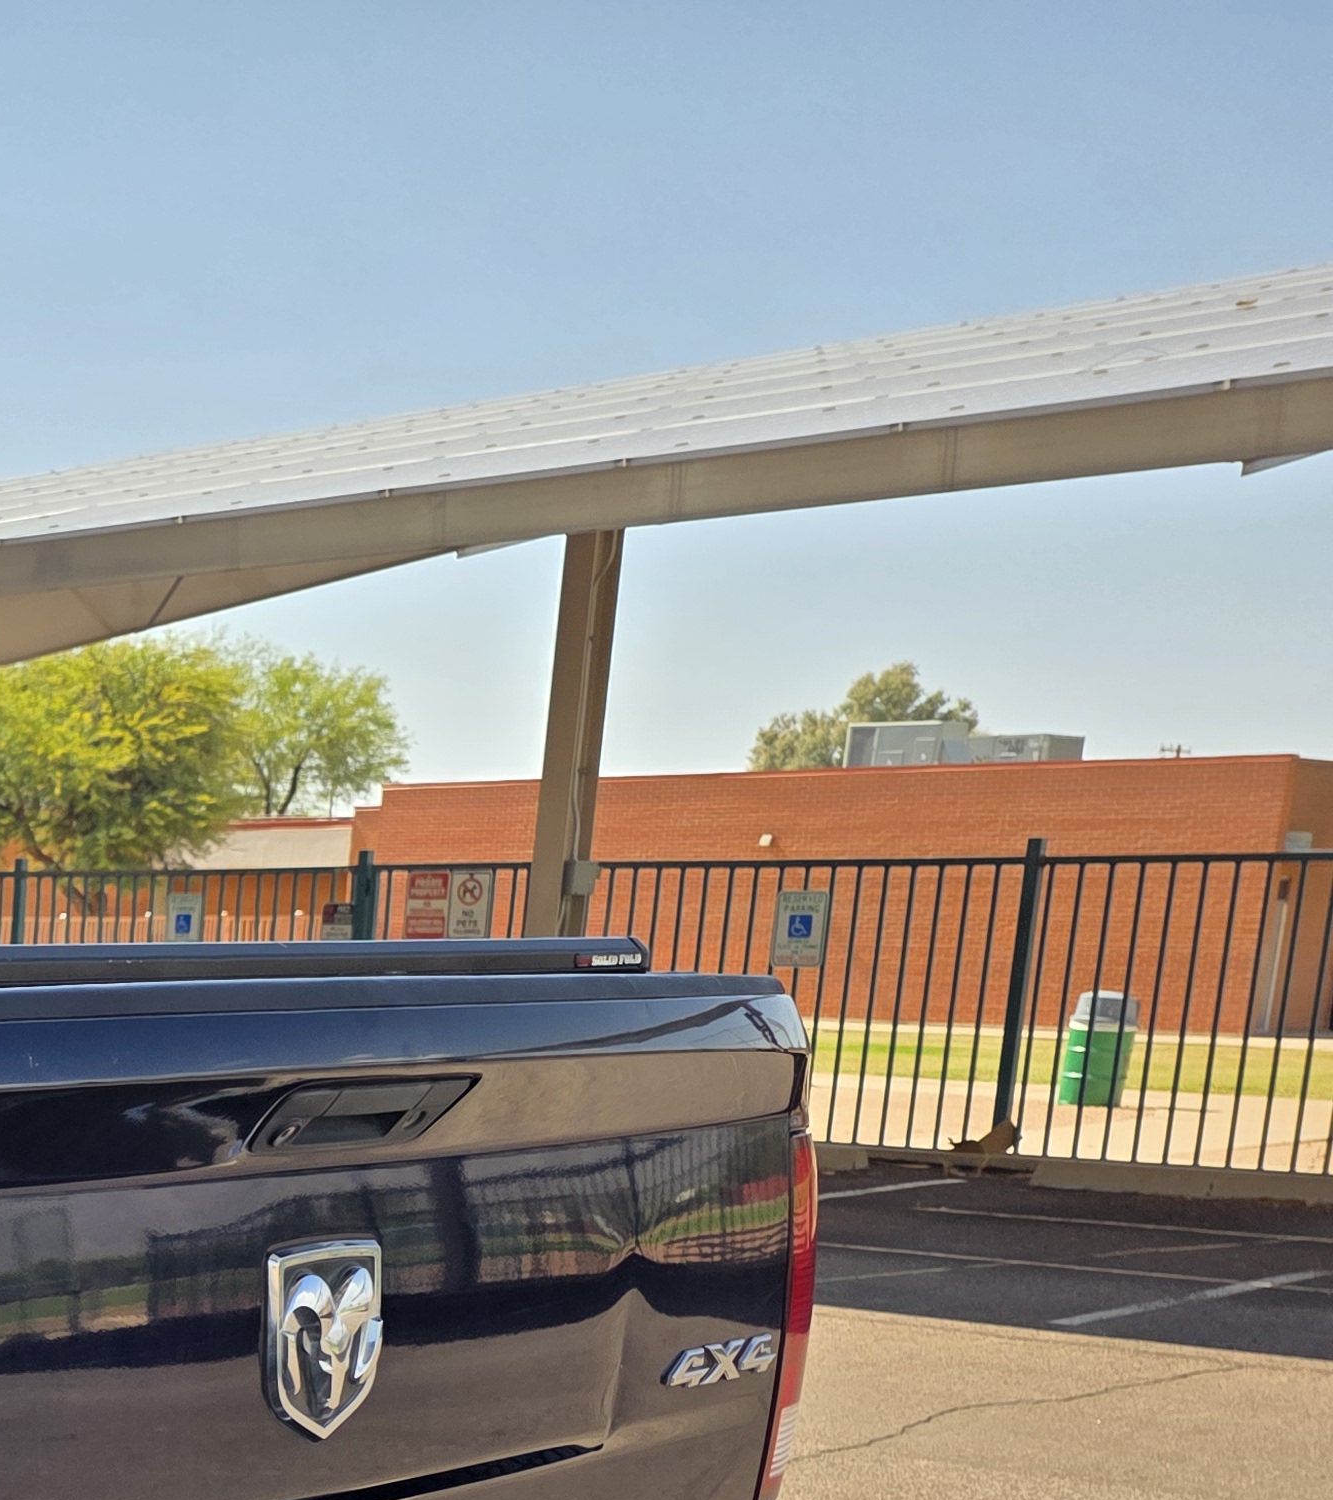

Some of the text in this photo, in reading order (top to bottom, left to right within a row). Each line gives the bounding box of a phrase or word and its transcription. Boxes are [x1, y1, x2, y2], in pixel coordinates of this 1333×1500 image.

[783, 894, 824, 904] RESERVED
[462, 909, 475, 918] NO
[784, 904, 821, 914] PARKING
[456, 919, 478, 928] PETS
[591, 954, 618, 966] SOLID
[619, 953, 642, 965] FOLD
[666, 1333, 776, 1388] 4X4
